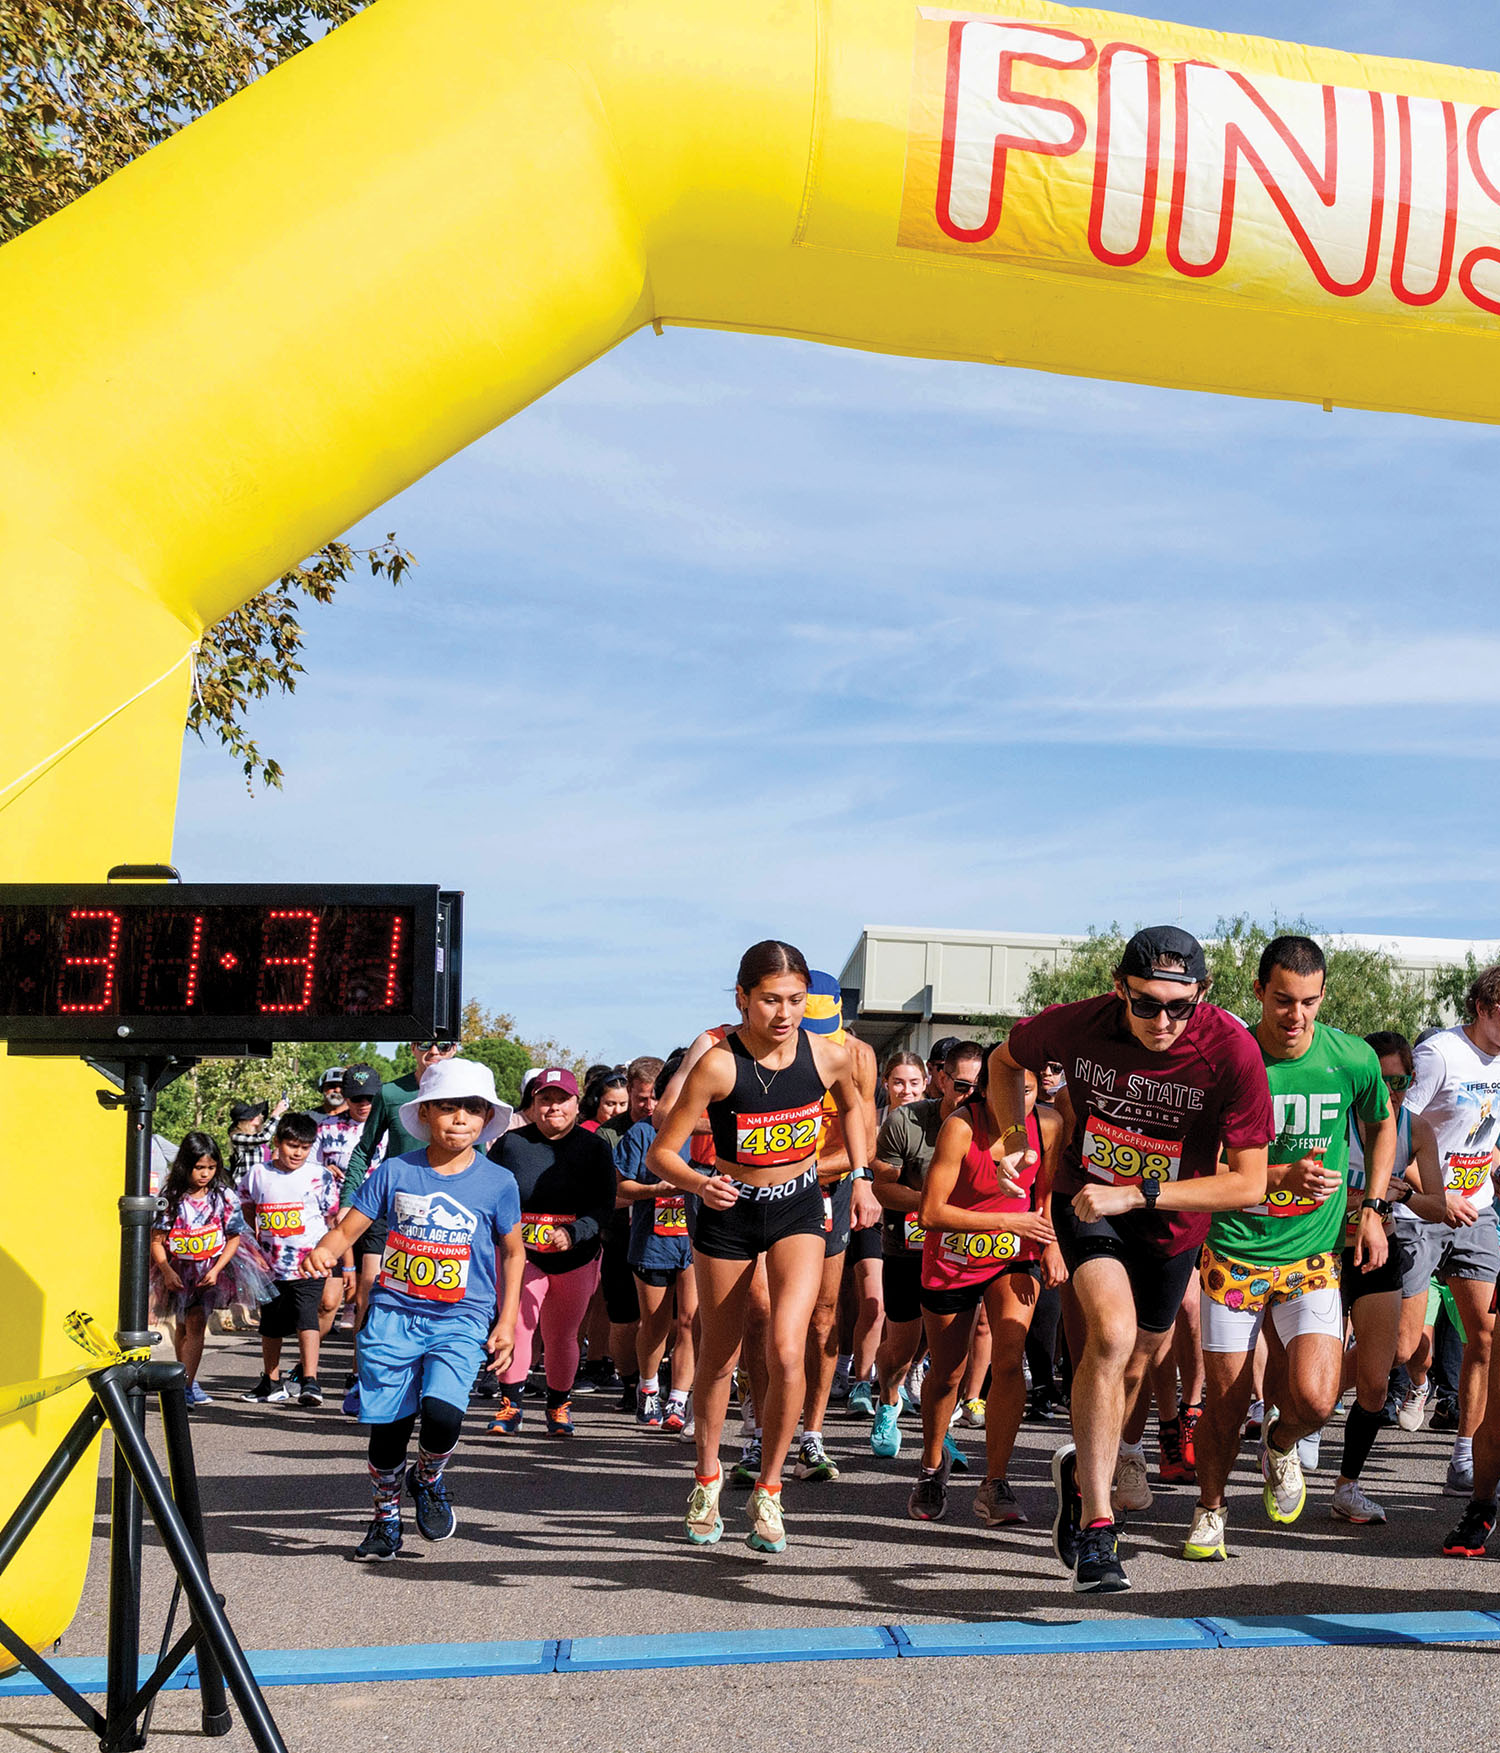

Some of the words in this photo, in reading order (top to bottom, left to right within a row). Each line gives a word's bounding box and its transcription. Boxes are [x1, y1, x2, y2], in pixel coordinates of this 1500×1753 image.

[1075, 1057, 1117, 1093] NM
[1126, 1074, 1205, 1110] STATE
[1470, 1083, 1489, 1091] FEEL
[746, 1117, 762, 1125] NM
[763, 1105, 820, 1123] RACEFUNDING
[1124, 1106, 1180, 1123] AGGIES
[1270, 1093, 1341, 1135] DF
[741, 1119, 816, 1156] 482
[1095, 1123, 1111, 1136] NM
[1111, 1130, 1180, 1153] RACEFUNDING
[1088, 1134, 1171, 1182] 398
[1448, 1163, 1492, 1191] 367
[755, 1179, 797, 1201] PRO
[259, 1210, 302, 1230] 308
[173, 1231, 218, 1254] 307
[405, 1242, 468, 1256] RACEFUNDING
[428, 1228, 448, 1242] AGE
[448, 1231, 473, 1245] CARE
[944, 1232, 1005, 1259] 408
[384, 1250, 462, 1291] 403
